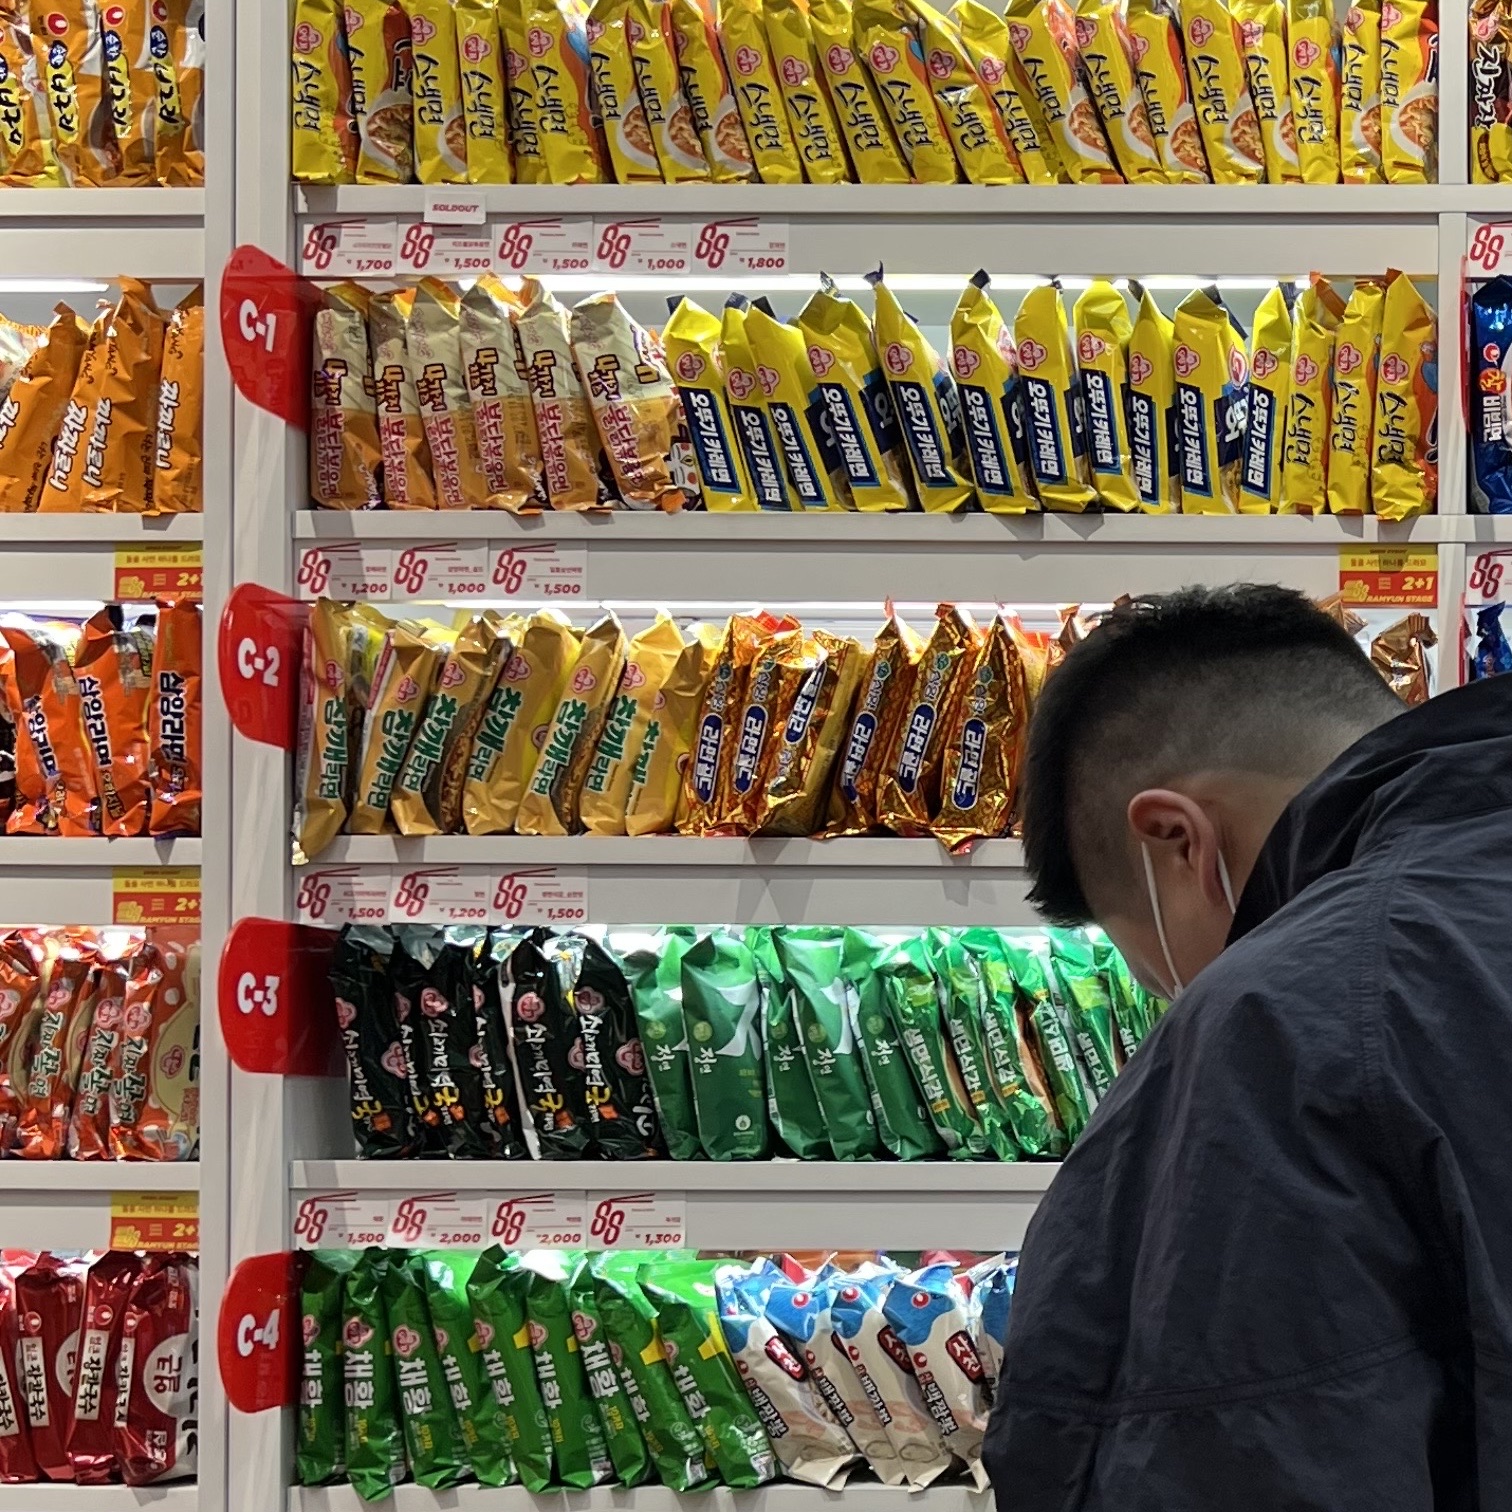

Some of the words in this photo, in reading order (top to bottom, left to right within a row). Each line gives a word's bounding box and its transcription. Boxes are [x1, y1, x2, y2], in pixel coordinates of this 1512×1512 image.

[293, 61, 322, 132] 스낵면
[413, 55, 445, 127] 스낵면
[1475, 42, 1501, 129] 진짜장
[49, 73, 79, 132] 너구리
[463, 70, 495, 141] 스낵면
[836, 83, 883, 152] 스낵면
[432, 203, 479, 213] SOLDOUT
[356, 259, 392, 271] 1,700
[454, 257, 490, 269] 1,500
[552, 258, 589, 270] 1,500
[647, 258, 685, 270] 1,000
[747, 257, 785, 269] 1,800
[239, 299, 275, 351] C-1
[351, 583, 388, 595] 1,200
[448, 583, 486, 595] 1,000
[544, 583, 581, 595] 1,500
[1402, 576, 1434, 590] 2+1
[238, 638, 280, 687] C-2
[77, 675, 111, 767] 삼양라면
[159, 671, 185, 763] 삼양라면
[348, 908, 385, 919] 1,500
[449, 907, 486, 919] 1,200
[548, 908, 584, 919] 1,500
[237, 971, 280, 1016] C-3
[905, 1028, 944, 1101] 생면식감
[347, 1233, 384, 1244] 1,500
[440, 1233, 480, 1244] 2,000
[540, 1233, 581, 1245] 2,000
[646, 1233, 681, 1244] 1,300
[237, 1309, 280, 1357] C-4
[345, 1350, 376, 1408] 채황
[581, 1340, 619, 1399] 채황
[78, 1357, 99, 1415] 장칼국수
[400, 1361, 434, 1414] 채황
